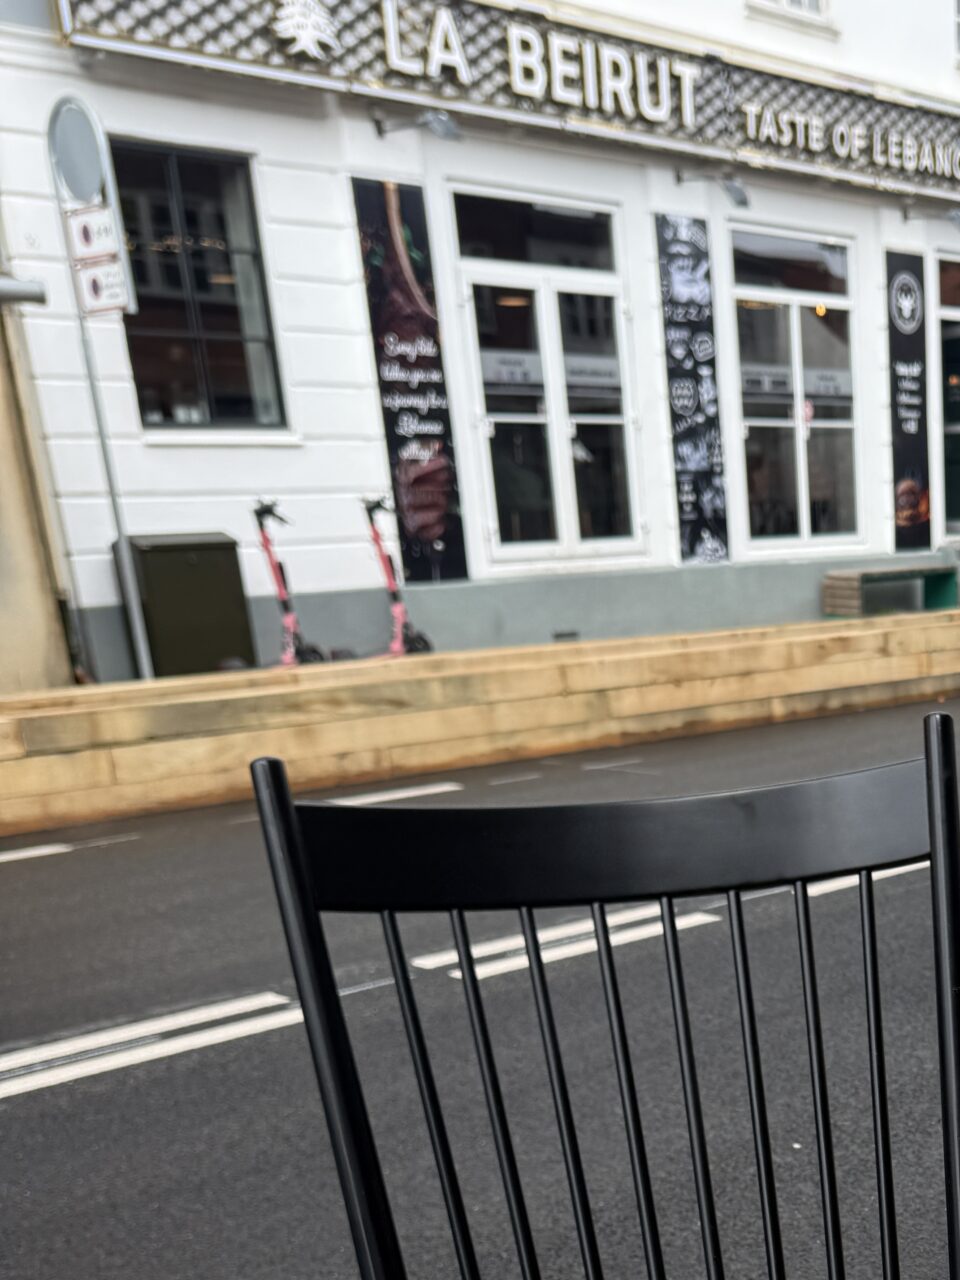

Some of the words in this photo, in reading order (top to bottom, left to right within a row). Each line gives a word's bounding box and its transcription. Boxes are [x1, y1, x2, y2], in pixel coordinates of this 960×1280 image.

[381, 0, 473, 86] LA
[507, 22, 700, 129] BEIRUT
[742, 102, 825, 152] TASTE
[832, 123, 866, 160] OF
